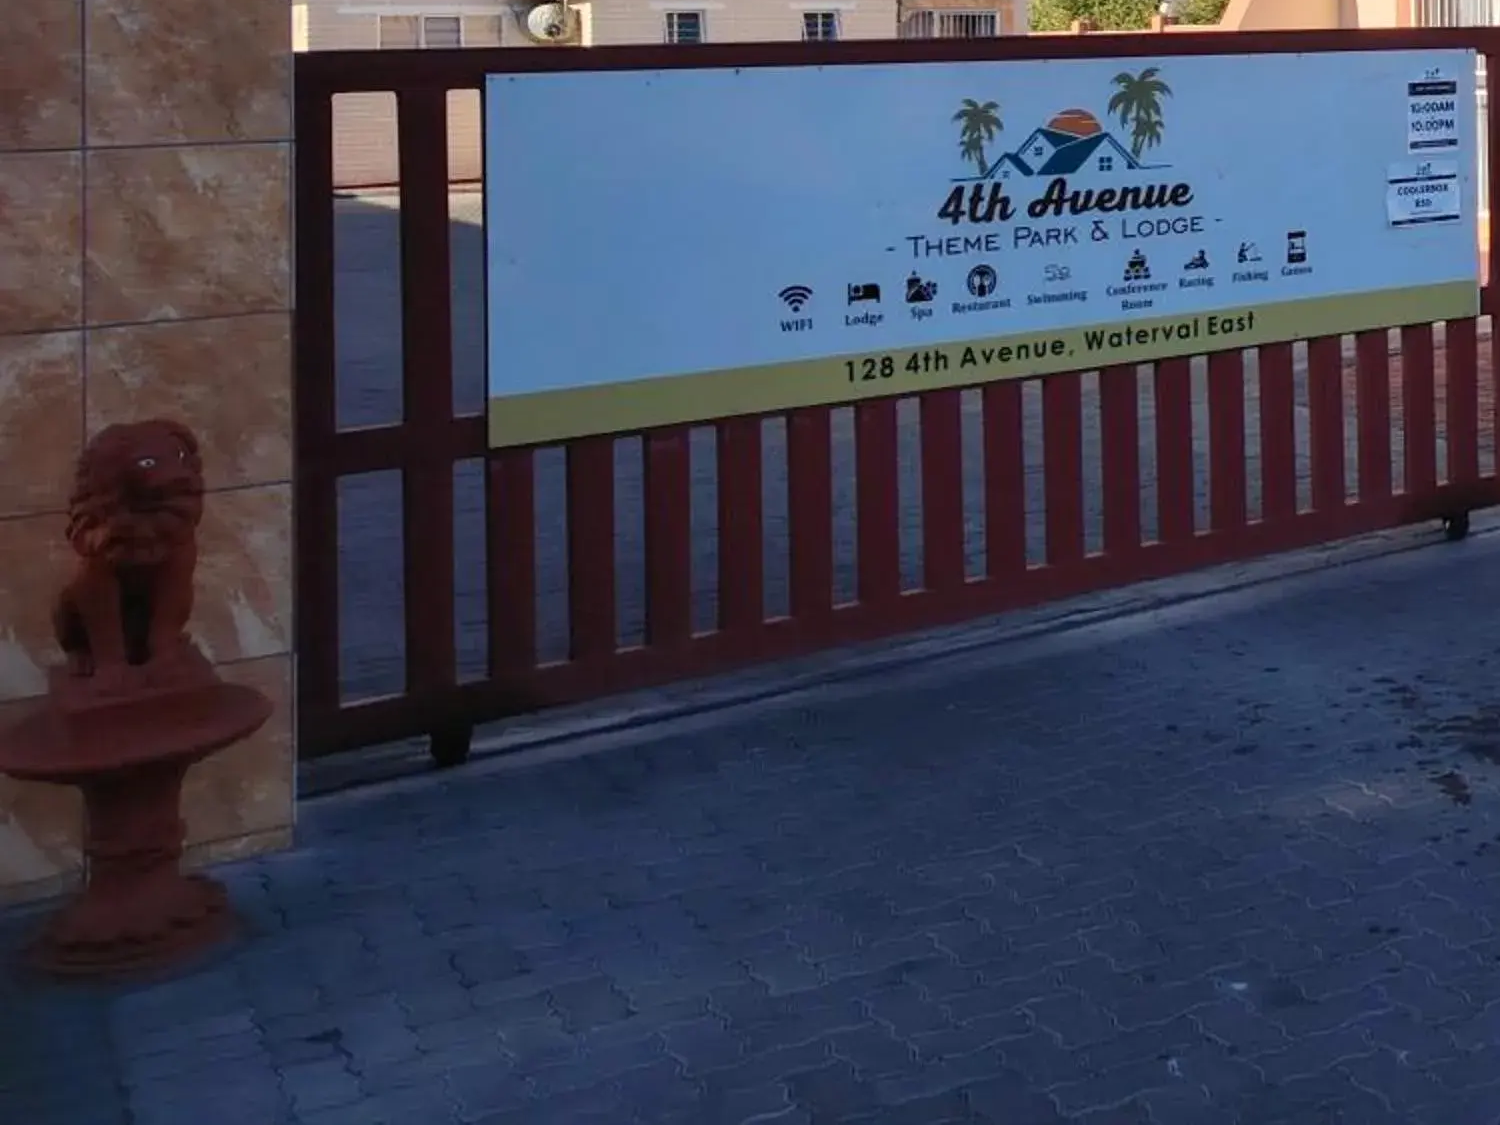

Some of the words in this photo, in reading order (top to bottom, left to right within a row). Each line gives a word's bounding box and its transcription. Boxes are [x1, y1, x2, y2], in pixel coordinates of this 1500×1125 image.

[937, 181, 1016, 225] 4th
[1027, 177, 1194, 219] Avenue
[905, 233, 1001, 259] THEME
[1013, 226, 1079, 250] PARK
[1091, 220, 1110, 242] &
[1121, 216, 1205, 239] LODGE
[1178, 276, 1215, 289] Racing
[1232, 269, 1269, 284] Fishing
[1106, 280, 1168, 297] Conference
[1026, 290, 1088, 306] Swimming
[1121, 298, 1153, 311] Room
[845, 310, 884, 327] Lodge
[910, 306, 934, 322] Spa
[780, 318, 813, 333] WIFI
[845, 357, 895, 382] 128
[905, 348, 949, 374] 4th
[960, 337, 1076, 368] Avenue,
[1084, 317, 1200, 351] Waterval
[1207, 311, 1255, 336] East
